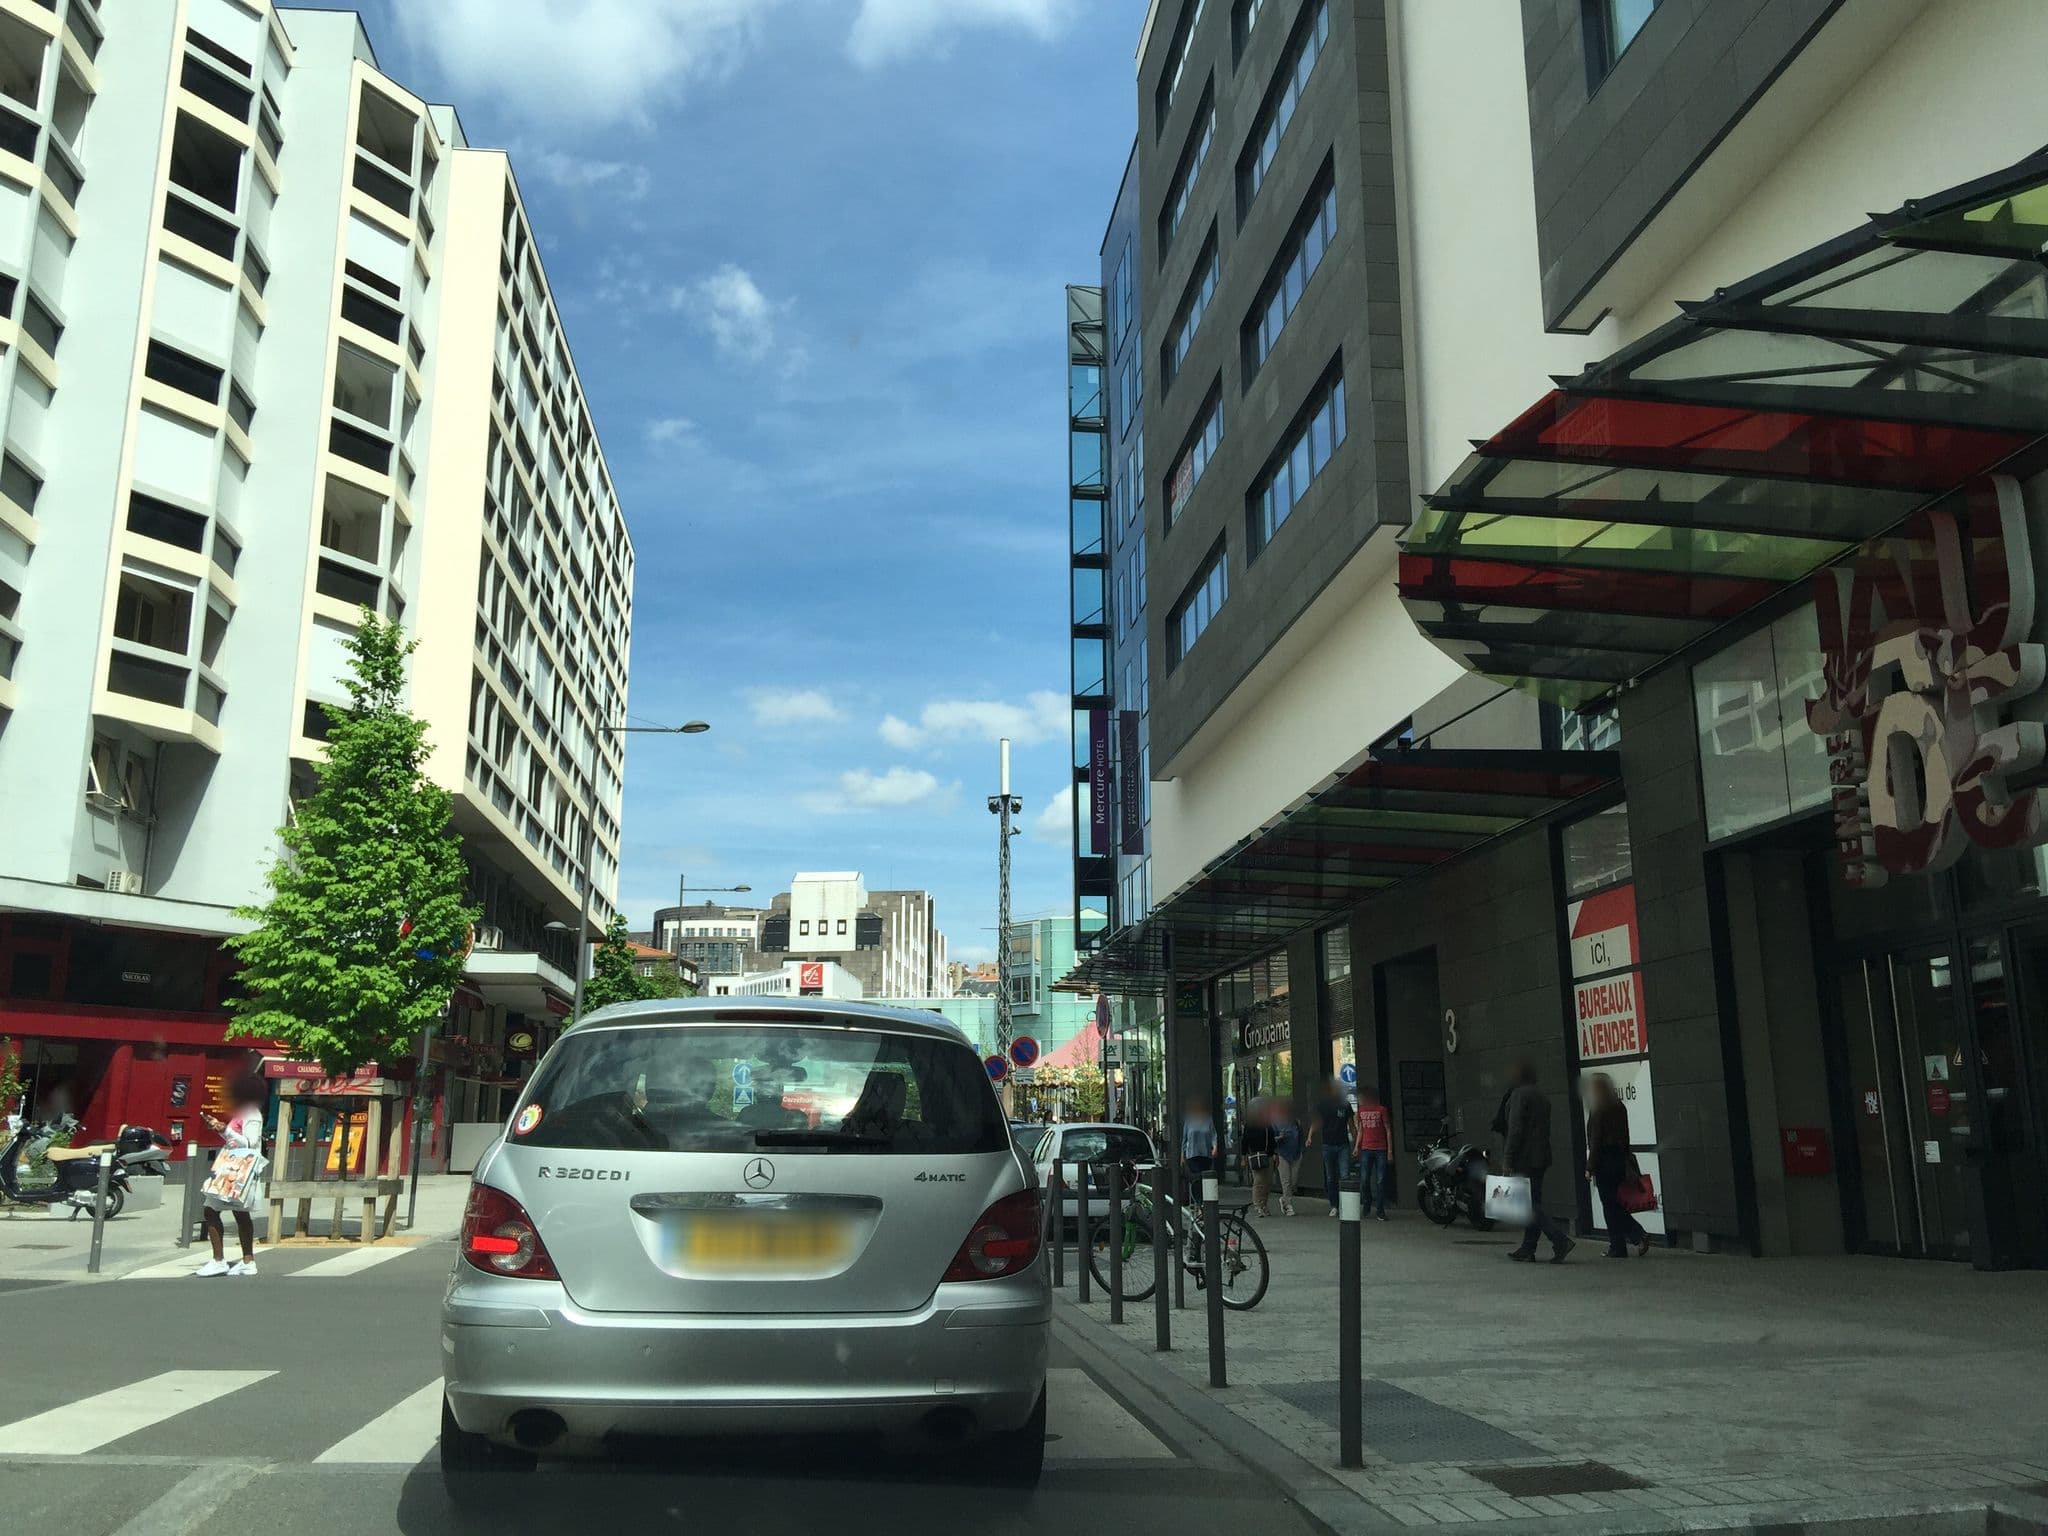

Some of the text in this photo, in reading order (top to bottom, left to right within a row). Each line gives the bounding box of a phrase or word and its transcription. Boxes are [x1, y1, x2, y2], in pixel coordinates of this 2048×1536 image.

[1095, 737, 1105, 825] Mercure HOTEL
[1589, 935, 1611, 966] ici,
[1577, 980, 1632, 1020] BUREAUX
[1244, 1020, 1290, 1050] Groupama
[1445, 1008, 1457, 1053] 3
[1580, 1018, 1636, 1057] À VENDRE
[538, 1166, 551, 1178] R
[913, 1171, 966, 1182] 4MATIC
